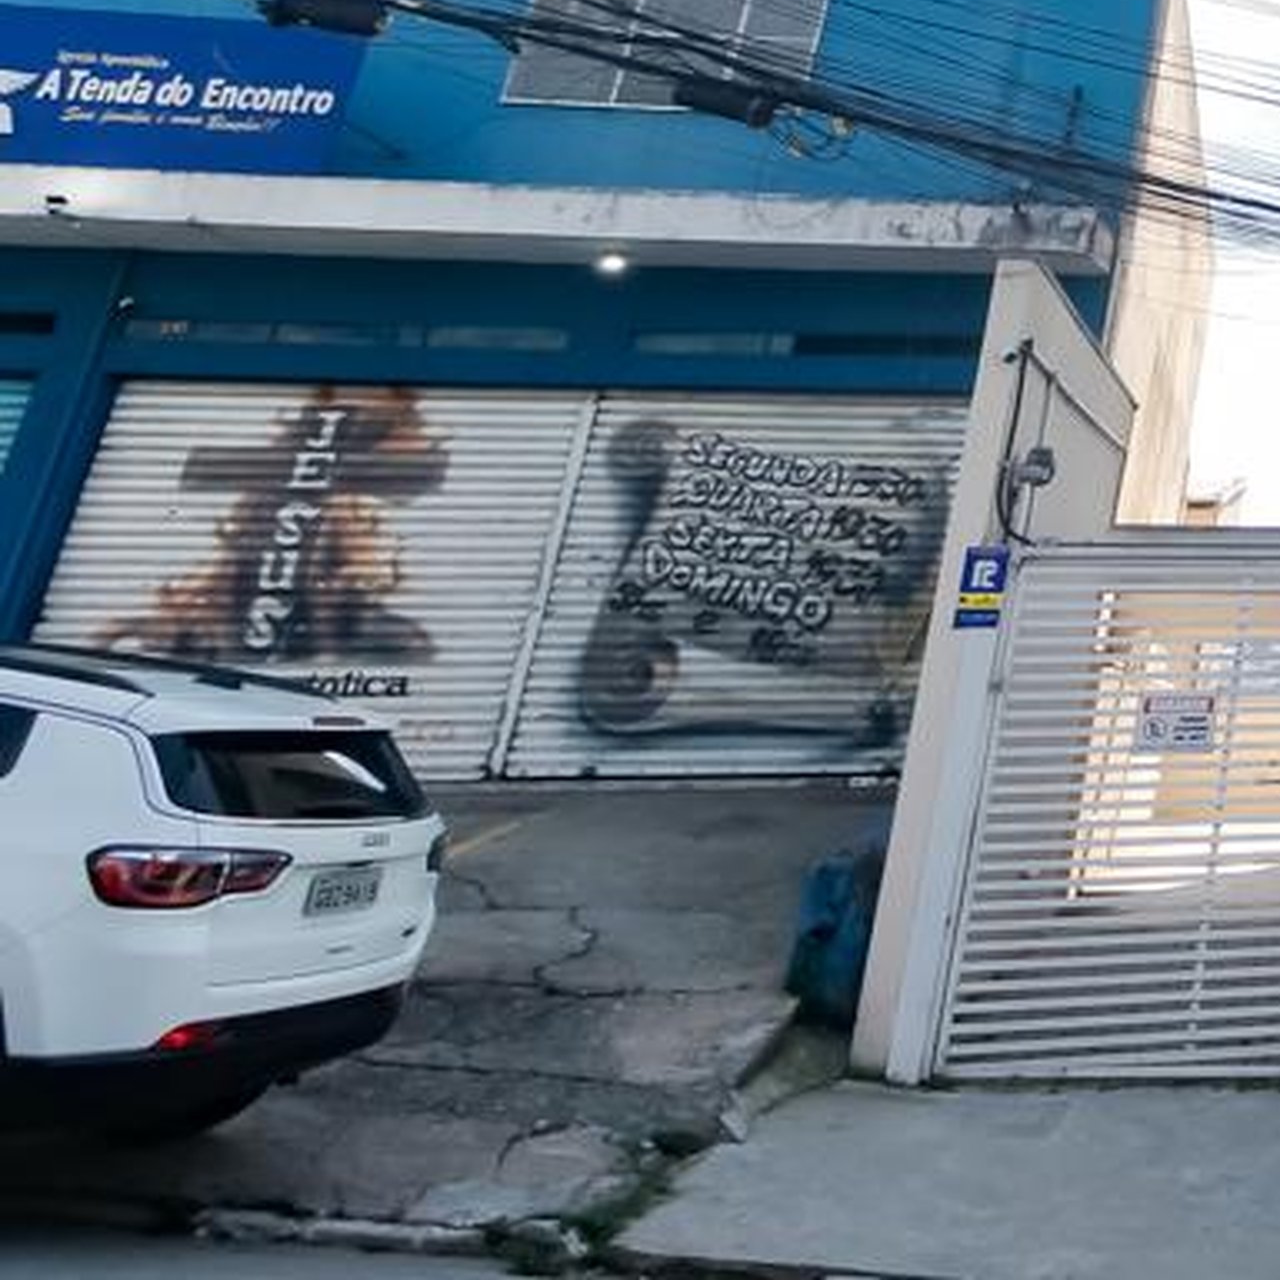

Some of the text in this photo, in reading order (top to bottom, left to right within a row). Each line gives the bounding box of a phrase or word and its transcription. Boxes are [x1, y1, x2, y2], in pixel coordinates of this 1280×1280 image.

[36, 68, 335, 116] A Tenda do Encontro
[243, 409, 347, 649] JESUS
[640, 535, 833, 632] DOMINGO
[308, 671, 410, 697] tolica
